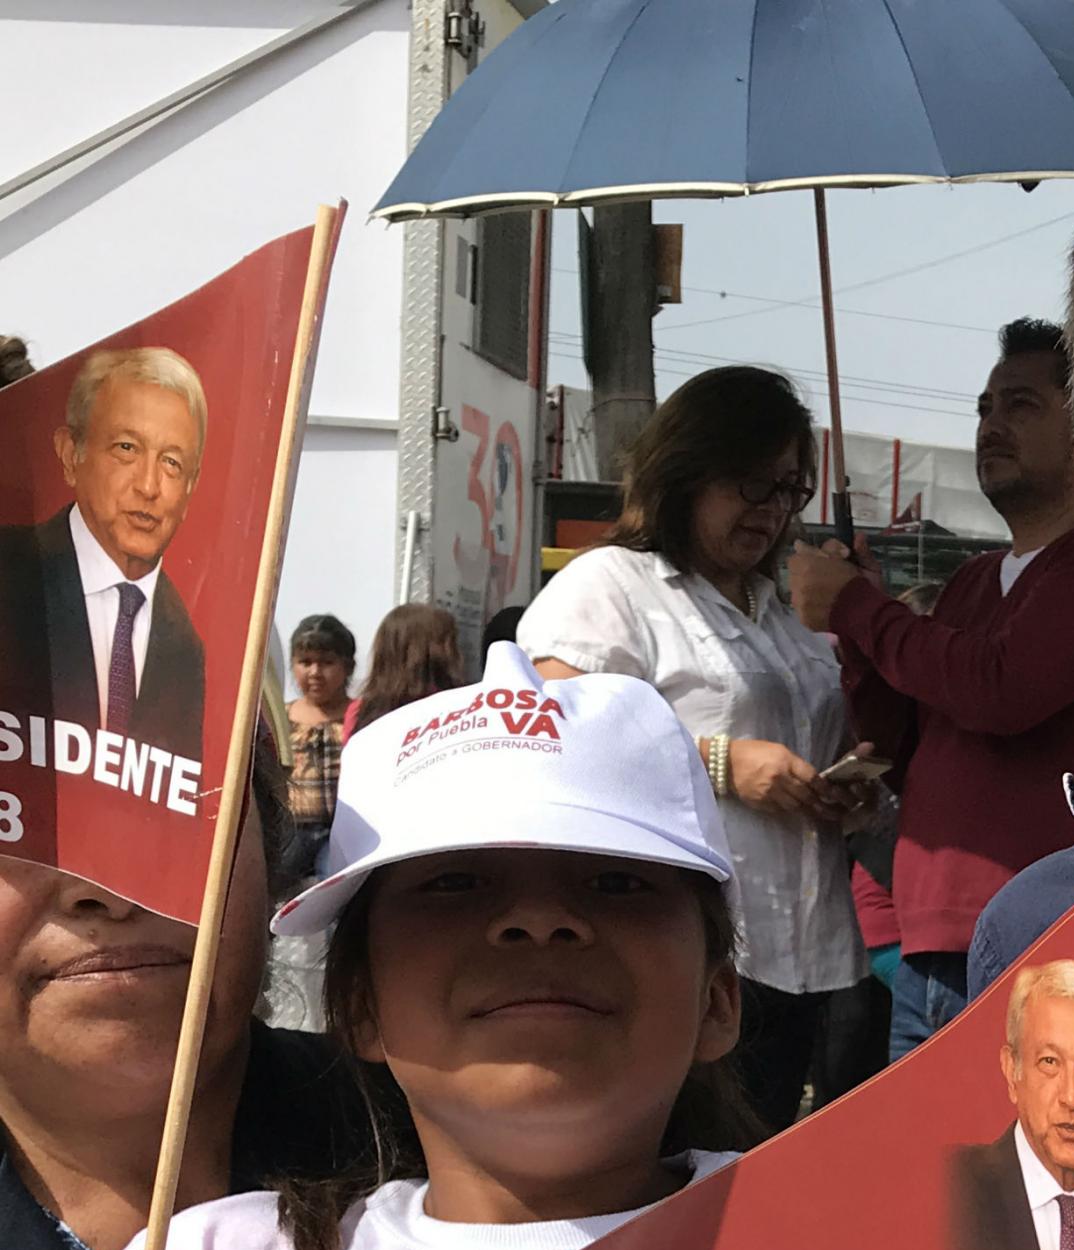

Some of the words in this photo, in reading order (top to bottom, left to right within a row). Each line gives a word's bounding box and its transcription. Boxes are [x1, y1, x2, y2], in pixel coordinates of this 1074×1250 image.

[402, 688, 568, 748] BARBOSA
[501, 711, 561, 740] VA
[396, 742, 422, 766] por
[428, 715, 488, 745] Puebla
[462, 739, 563, 755] GOBERNADOR
